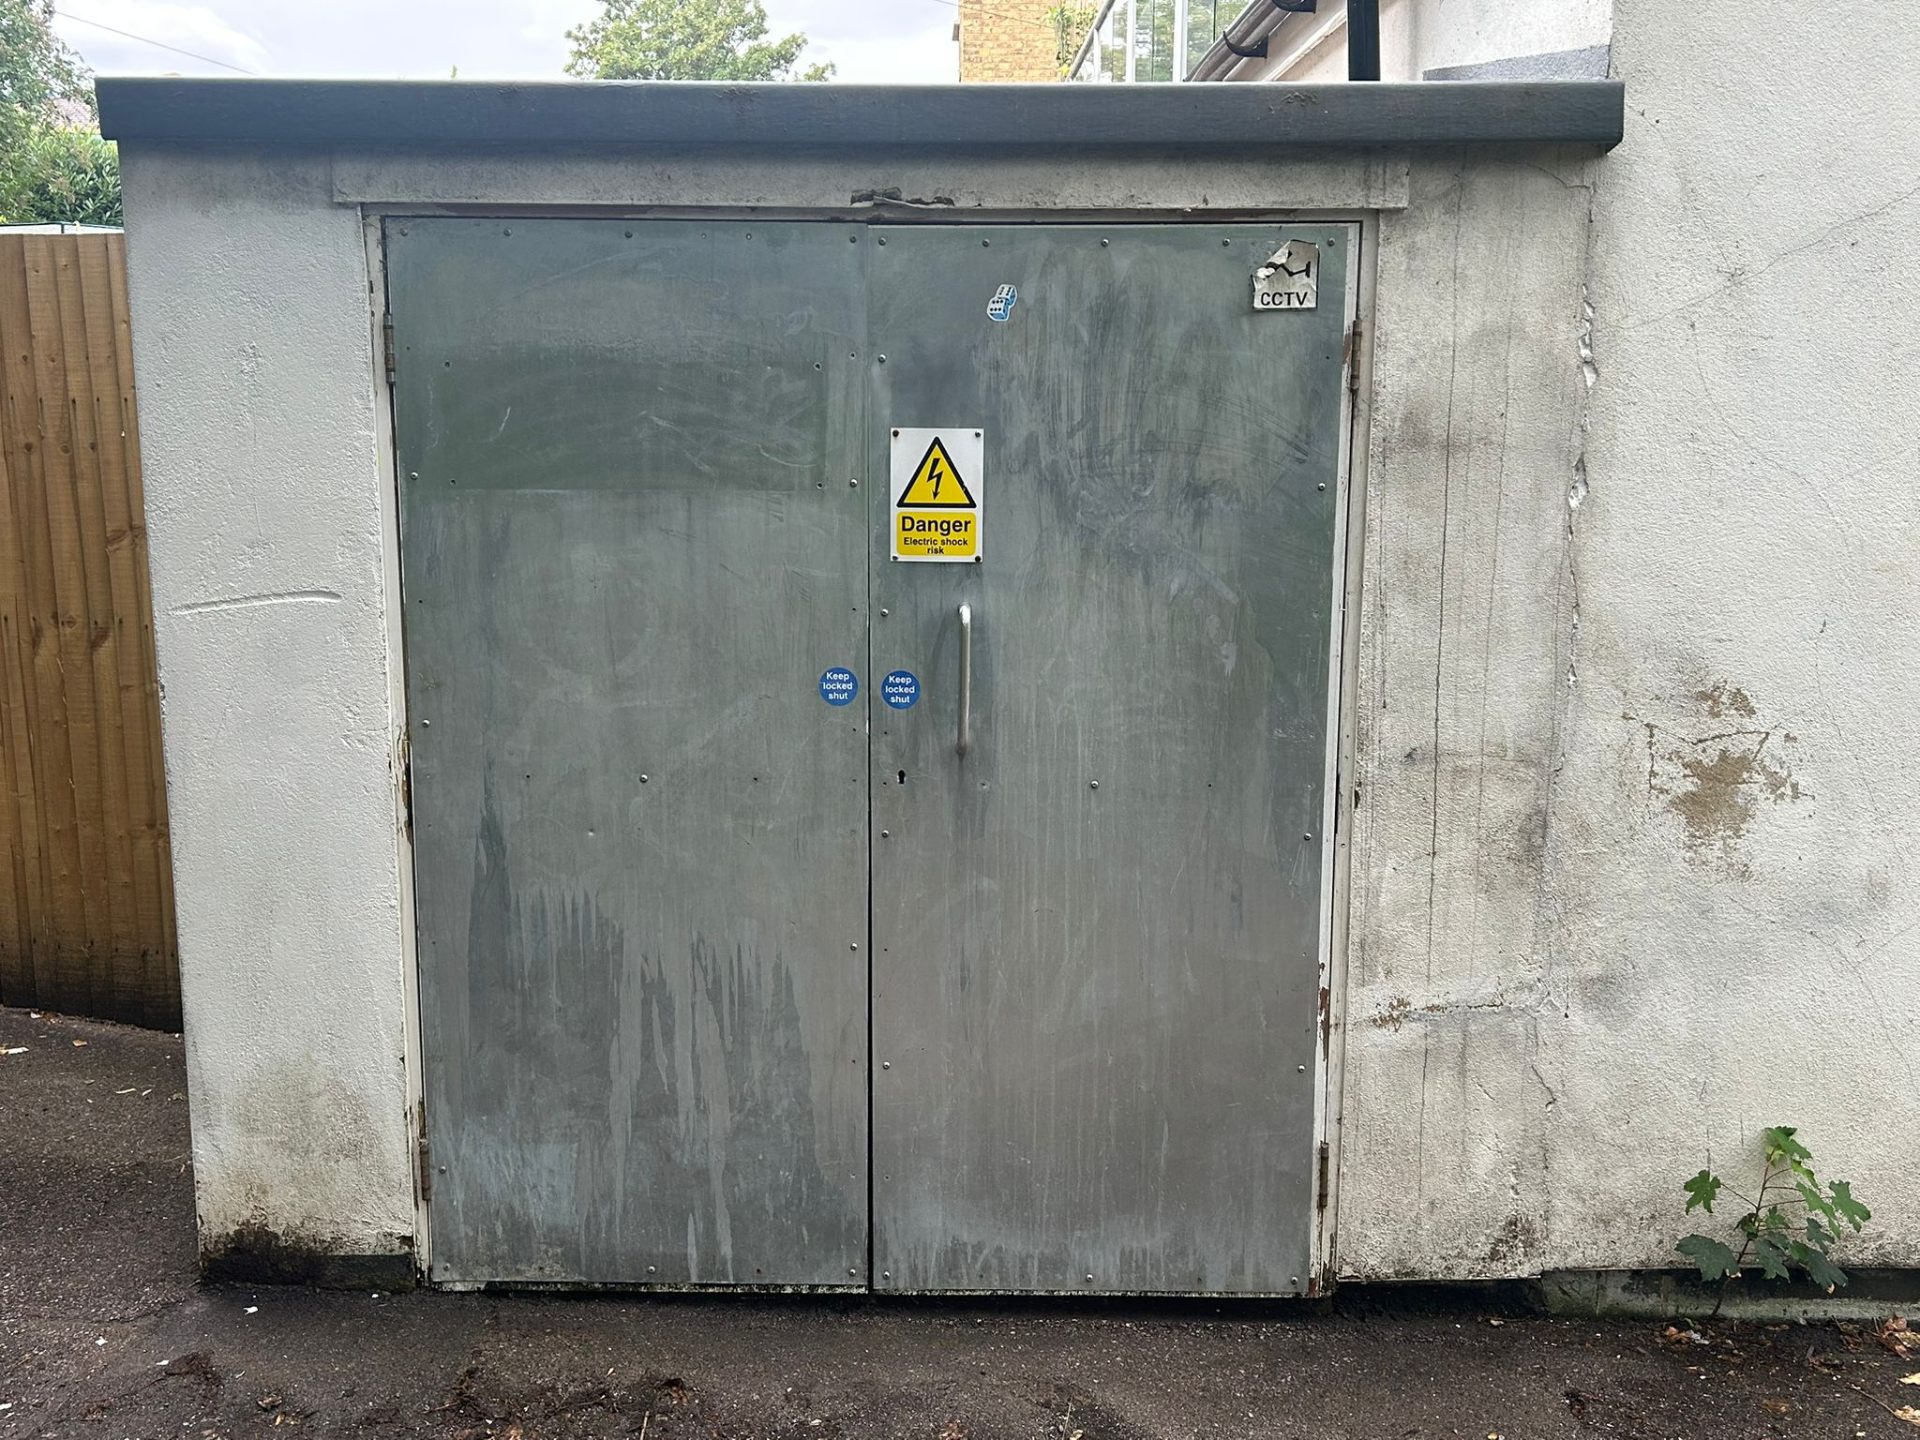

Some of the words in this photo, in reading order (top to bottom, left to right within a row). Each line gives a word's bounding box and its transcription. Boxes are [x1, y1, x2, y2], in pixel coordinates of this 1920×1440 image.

[1260, 291, 1308, 306] CCTV
[901, 516, 971, 536] Danger
[903, 537, 938, 546] Electric
[940, 537, 968, 546] shock
[927, 546, 945, 555] risk
[826, 672, 850, 682] Keep
[888, 675, 912, 685] Keep
[823, 682, 853, 690] locked
[885, 685, 915, 694] locked
[828, 692, 848, 700] shut
